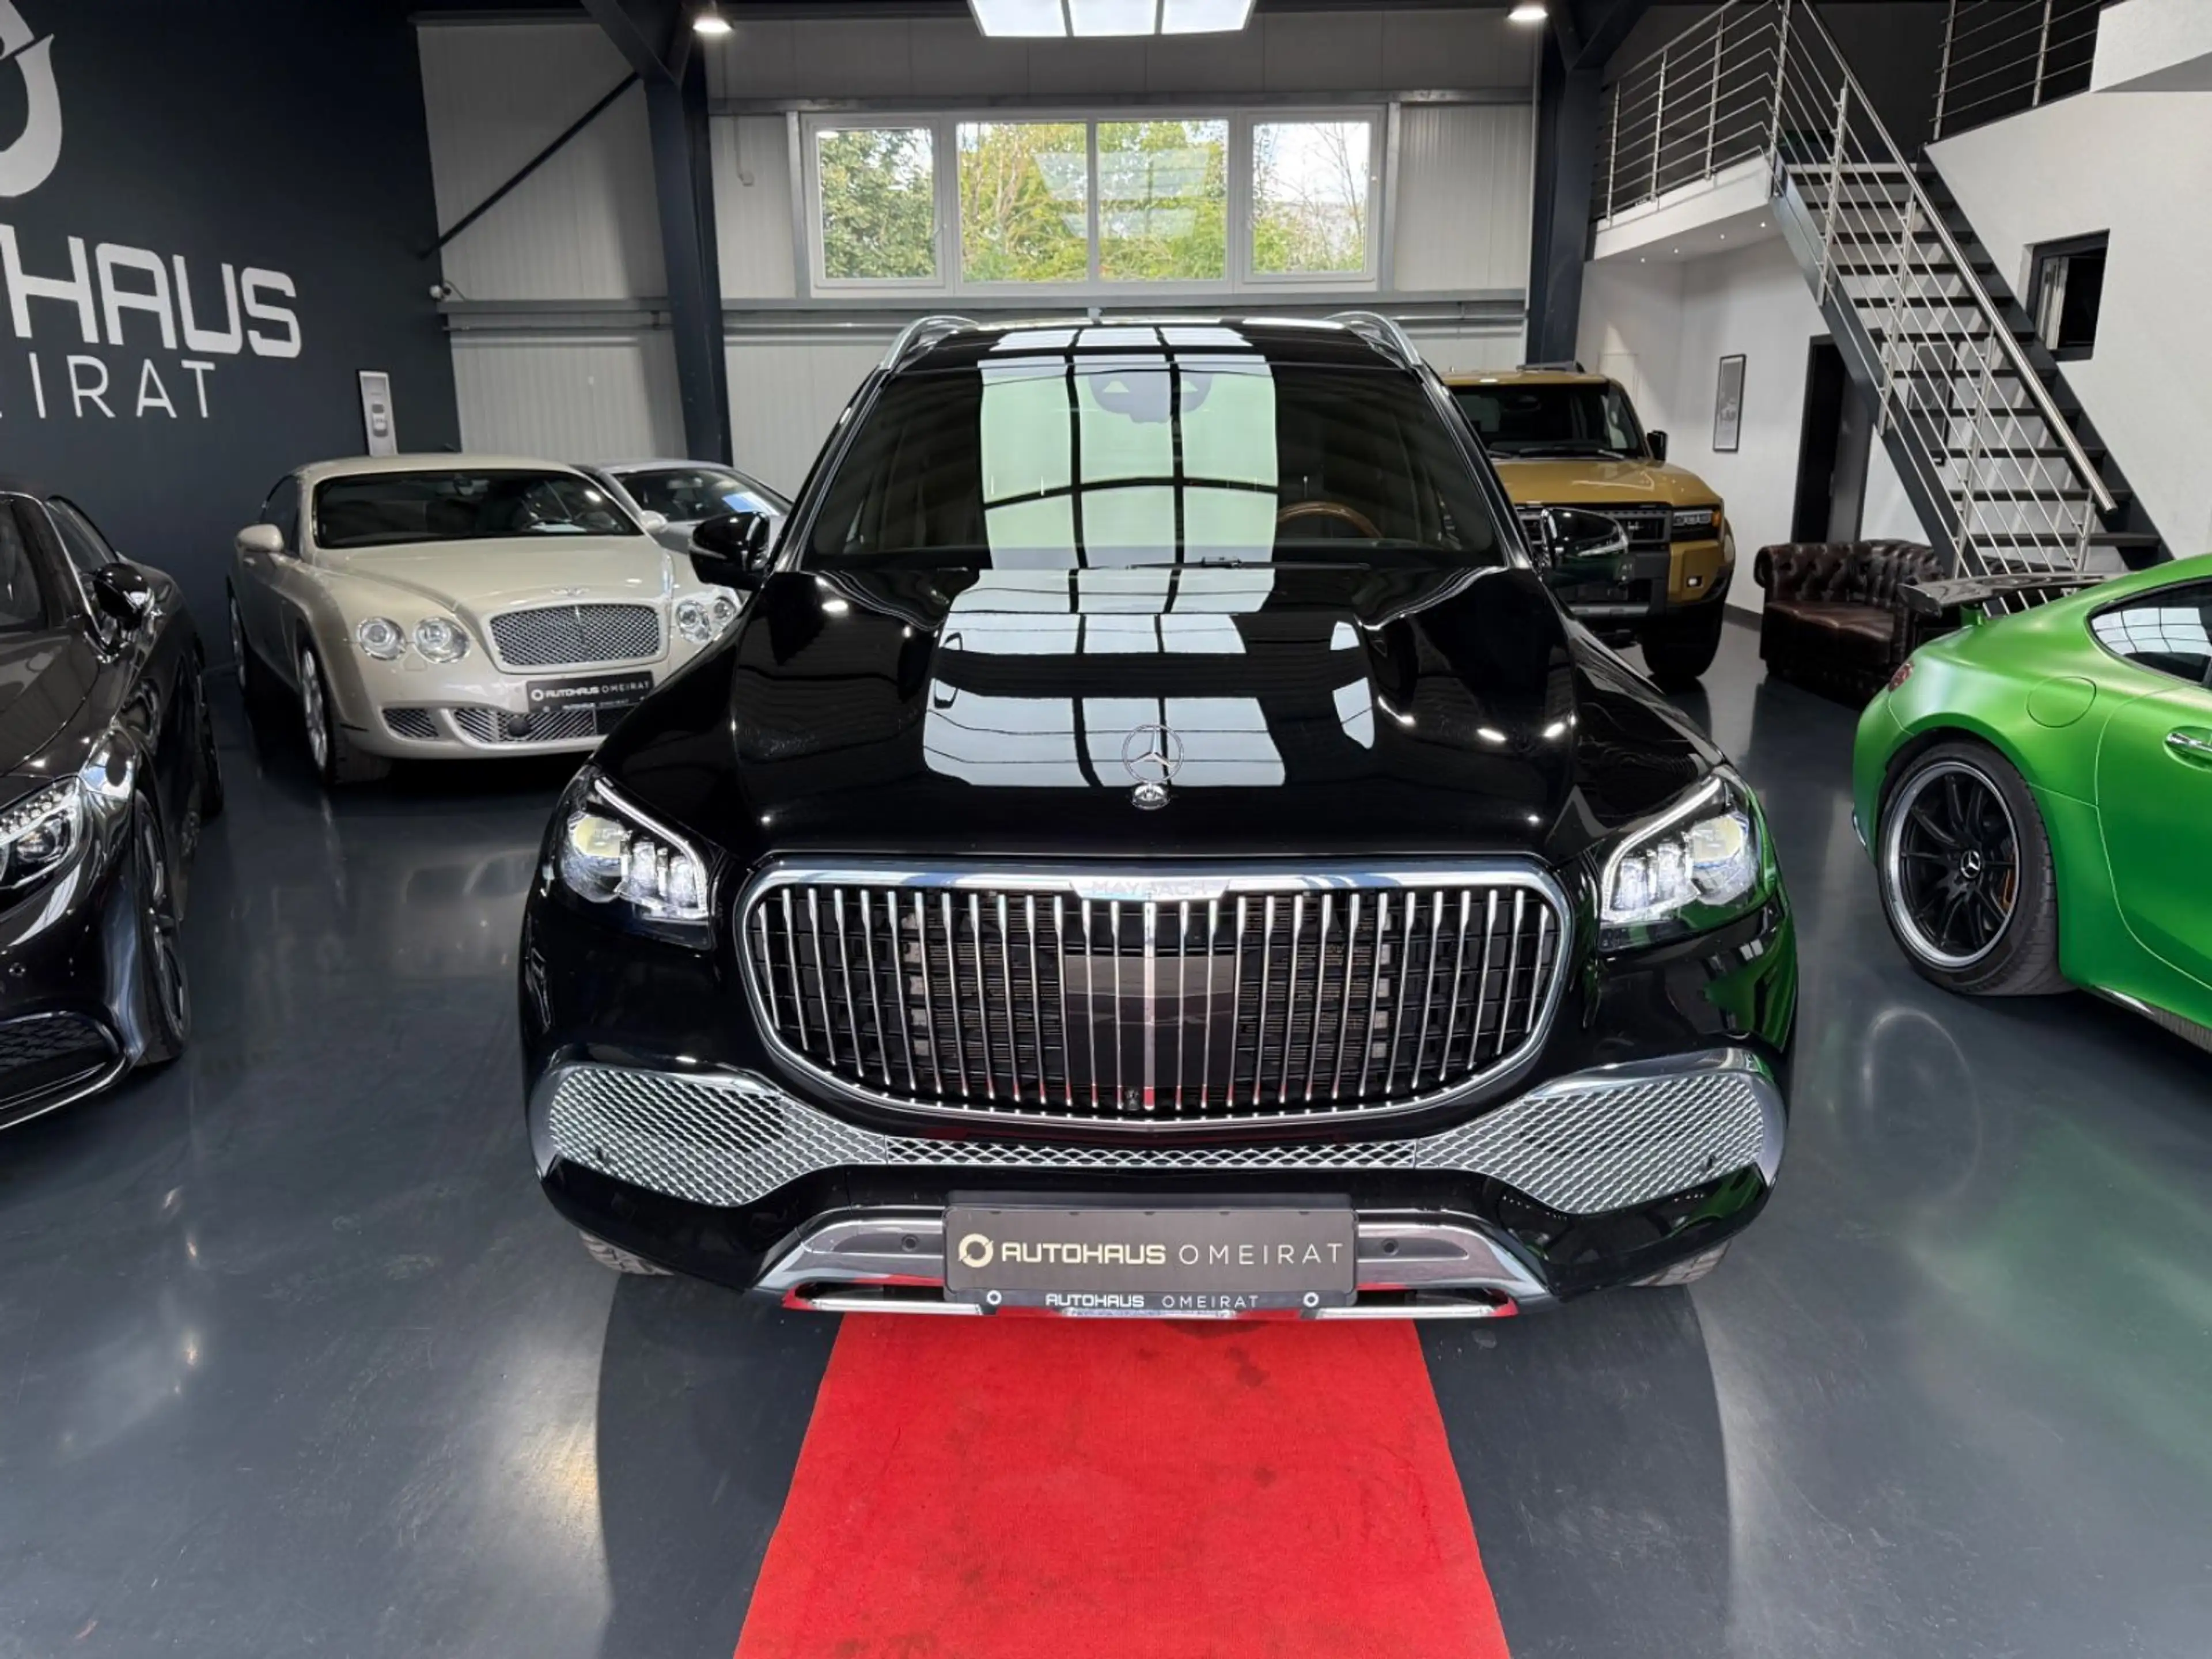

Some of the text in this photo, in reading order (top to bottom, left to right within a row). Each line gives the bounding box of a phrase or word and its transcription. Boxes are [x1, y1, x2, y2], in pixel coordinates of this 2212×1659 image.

[0, 223, 301, 358] HAUS
[0, 352, 215, 419] IRAT
[546, 680, 650, 698] AUTOHAUS OMEIRAT
[1092, 880, 1209, 896] MAYBACH
[1001, 1242, 1343, 1265] AUTOHAUS OMEIRAT
[1045, 1293, 1259, 1309] AUTOHAUS OMEIRAT
